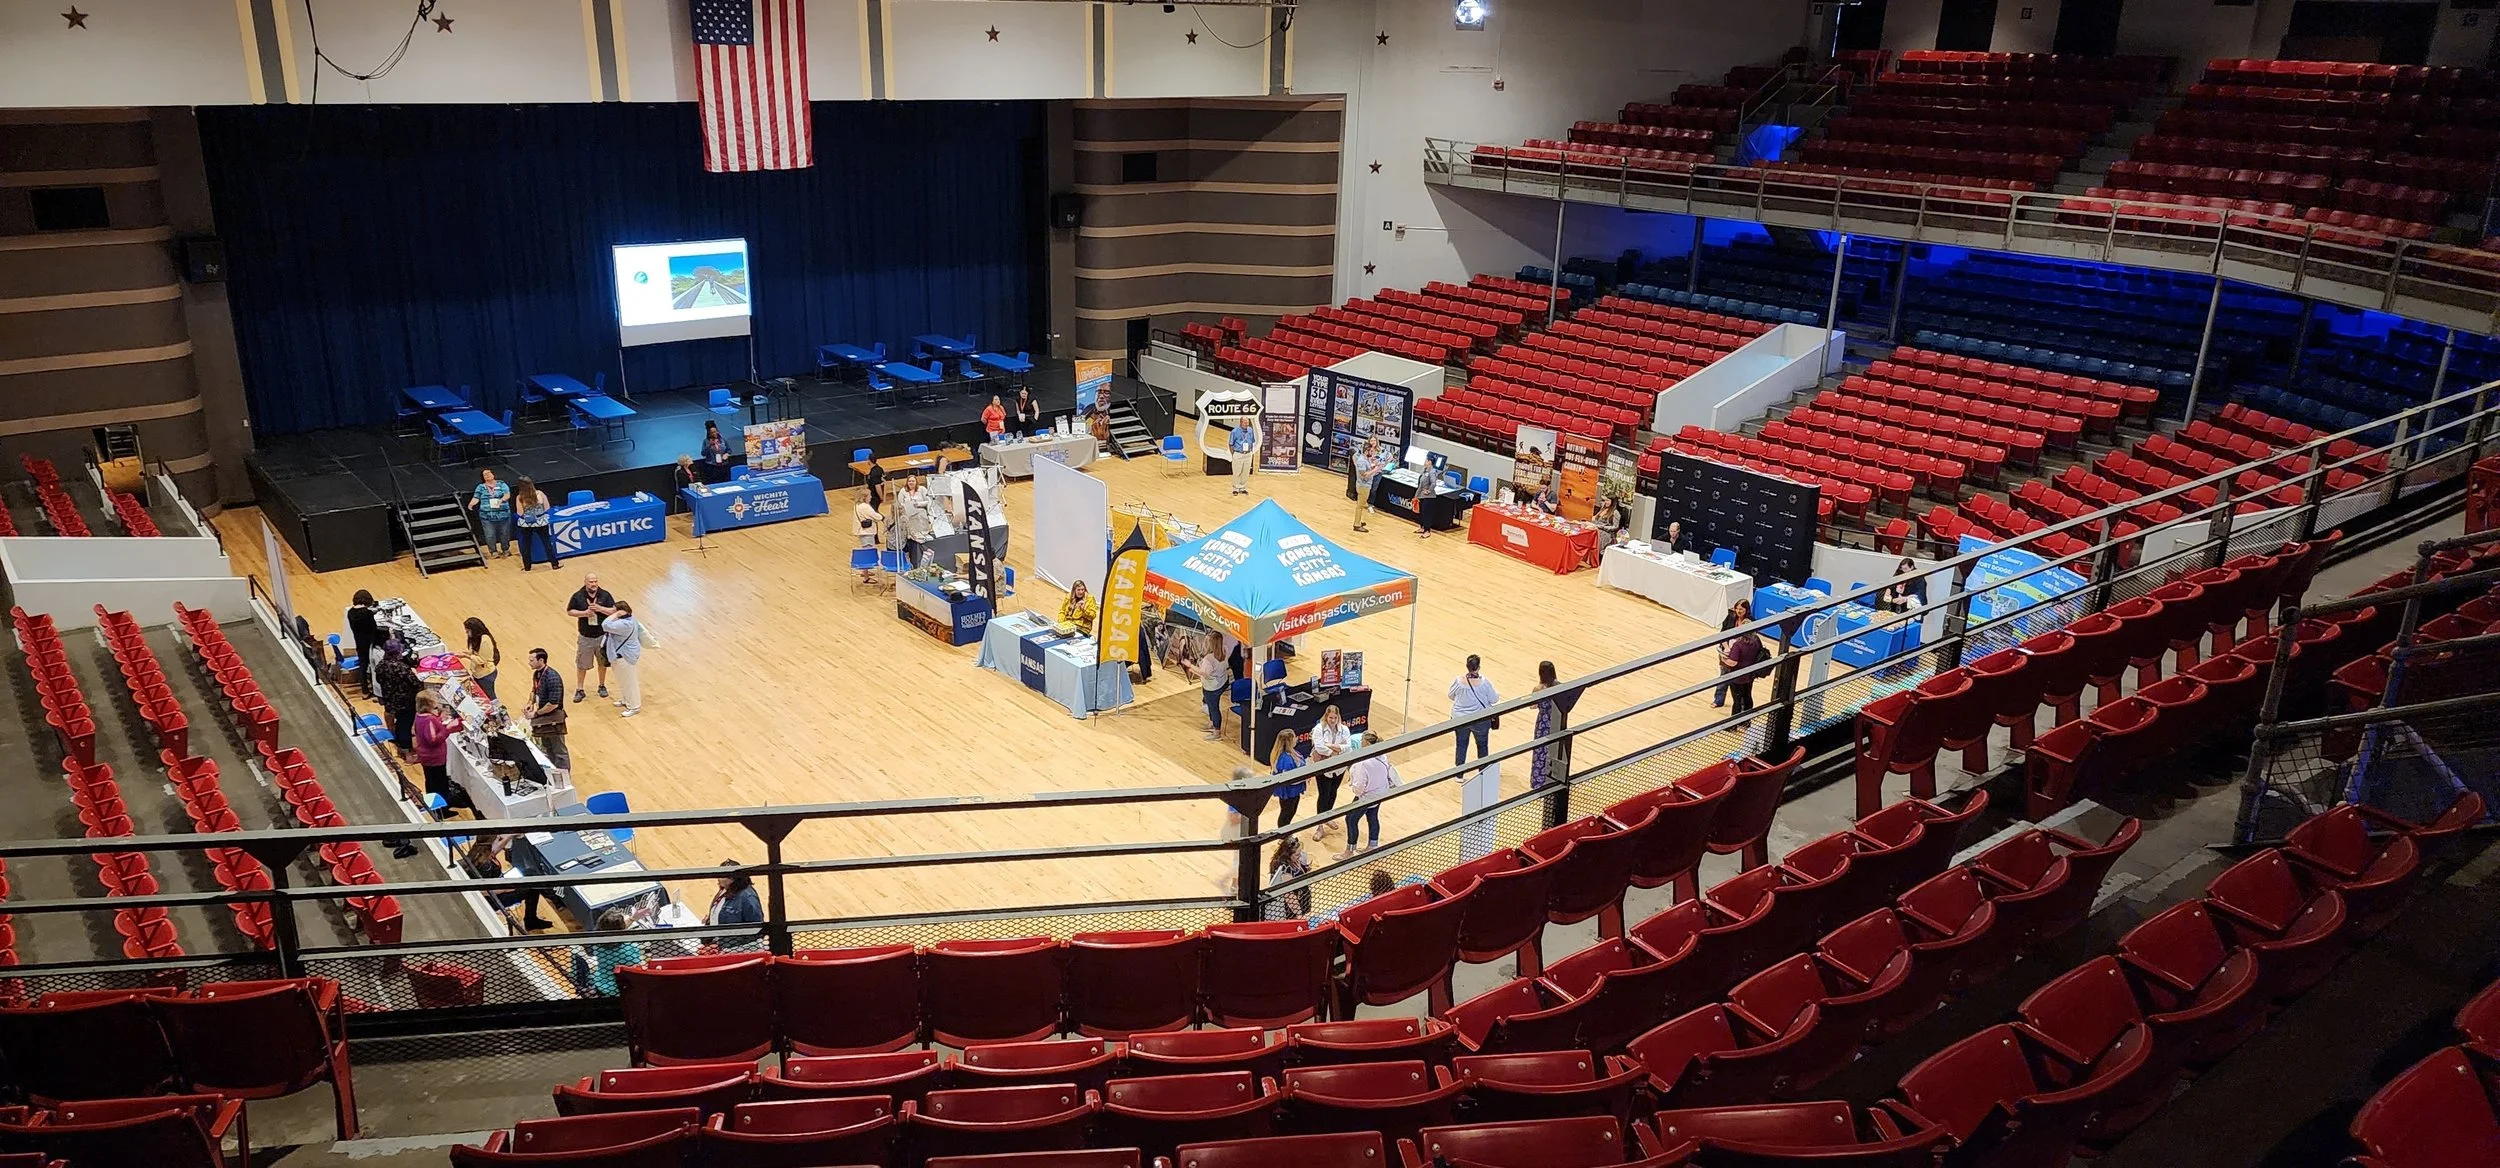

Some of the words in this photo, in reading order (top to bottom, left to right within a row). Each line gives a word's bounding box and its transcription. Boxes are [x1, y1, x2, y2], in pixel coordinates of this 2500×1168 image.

[1311, 387, 1327, 399] 3D
[1208, 404, 1241, 414] ROUTE
[1242, 403, 1257, 413] 66
[751, 499, 789, 513] Heart
[753, 490, 789, 501] WICHITA
[582, 520, 628, 539] VISIT
[631, 517, 654, 532] KC
[967, 500, 988, 599] KANSAS
[1200, 538, 1250, 565] KANSAS
[1277, 544, 1331, 567] KANSAS
[1999, 554, 2024, 567] Ordinary
[1182, 555, 1232, 583] KANSAS
[1292, 564, 1347, 587] KANSAS
[1979, 561, 1991, 569] ORT
[1991, 564, 2014, 575] DODGE!
[1110, 557, 1137, 662] KANSAS
[1144, 579, 1241, 632] sitKansasCityKS.com
[1273, 589, 1403, 634] VisitKansasCityKS.com
[1020, 653, 1044, 674] KANSAS
